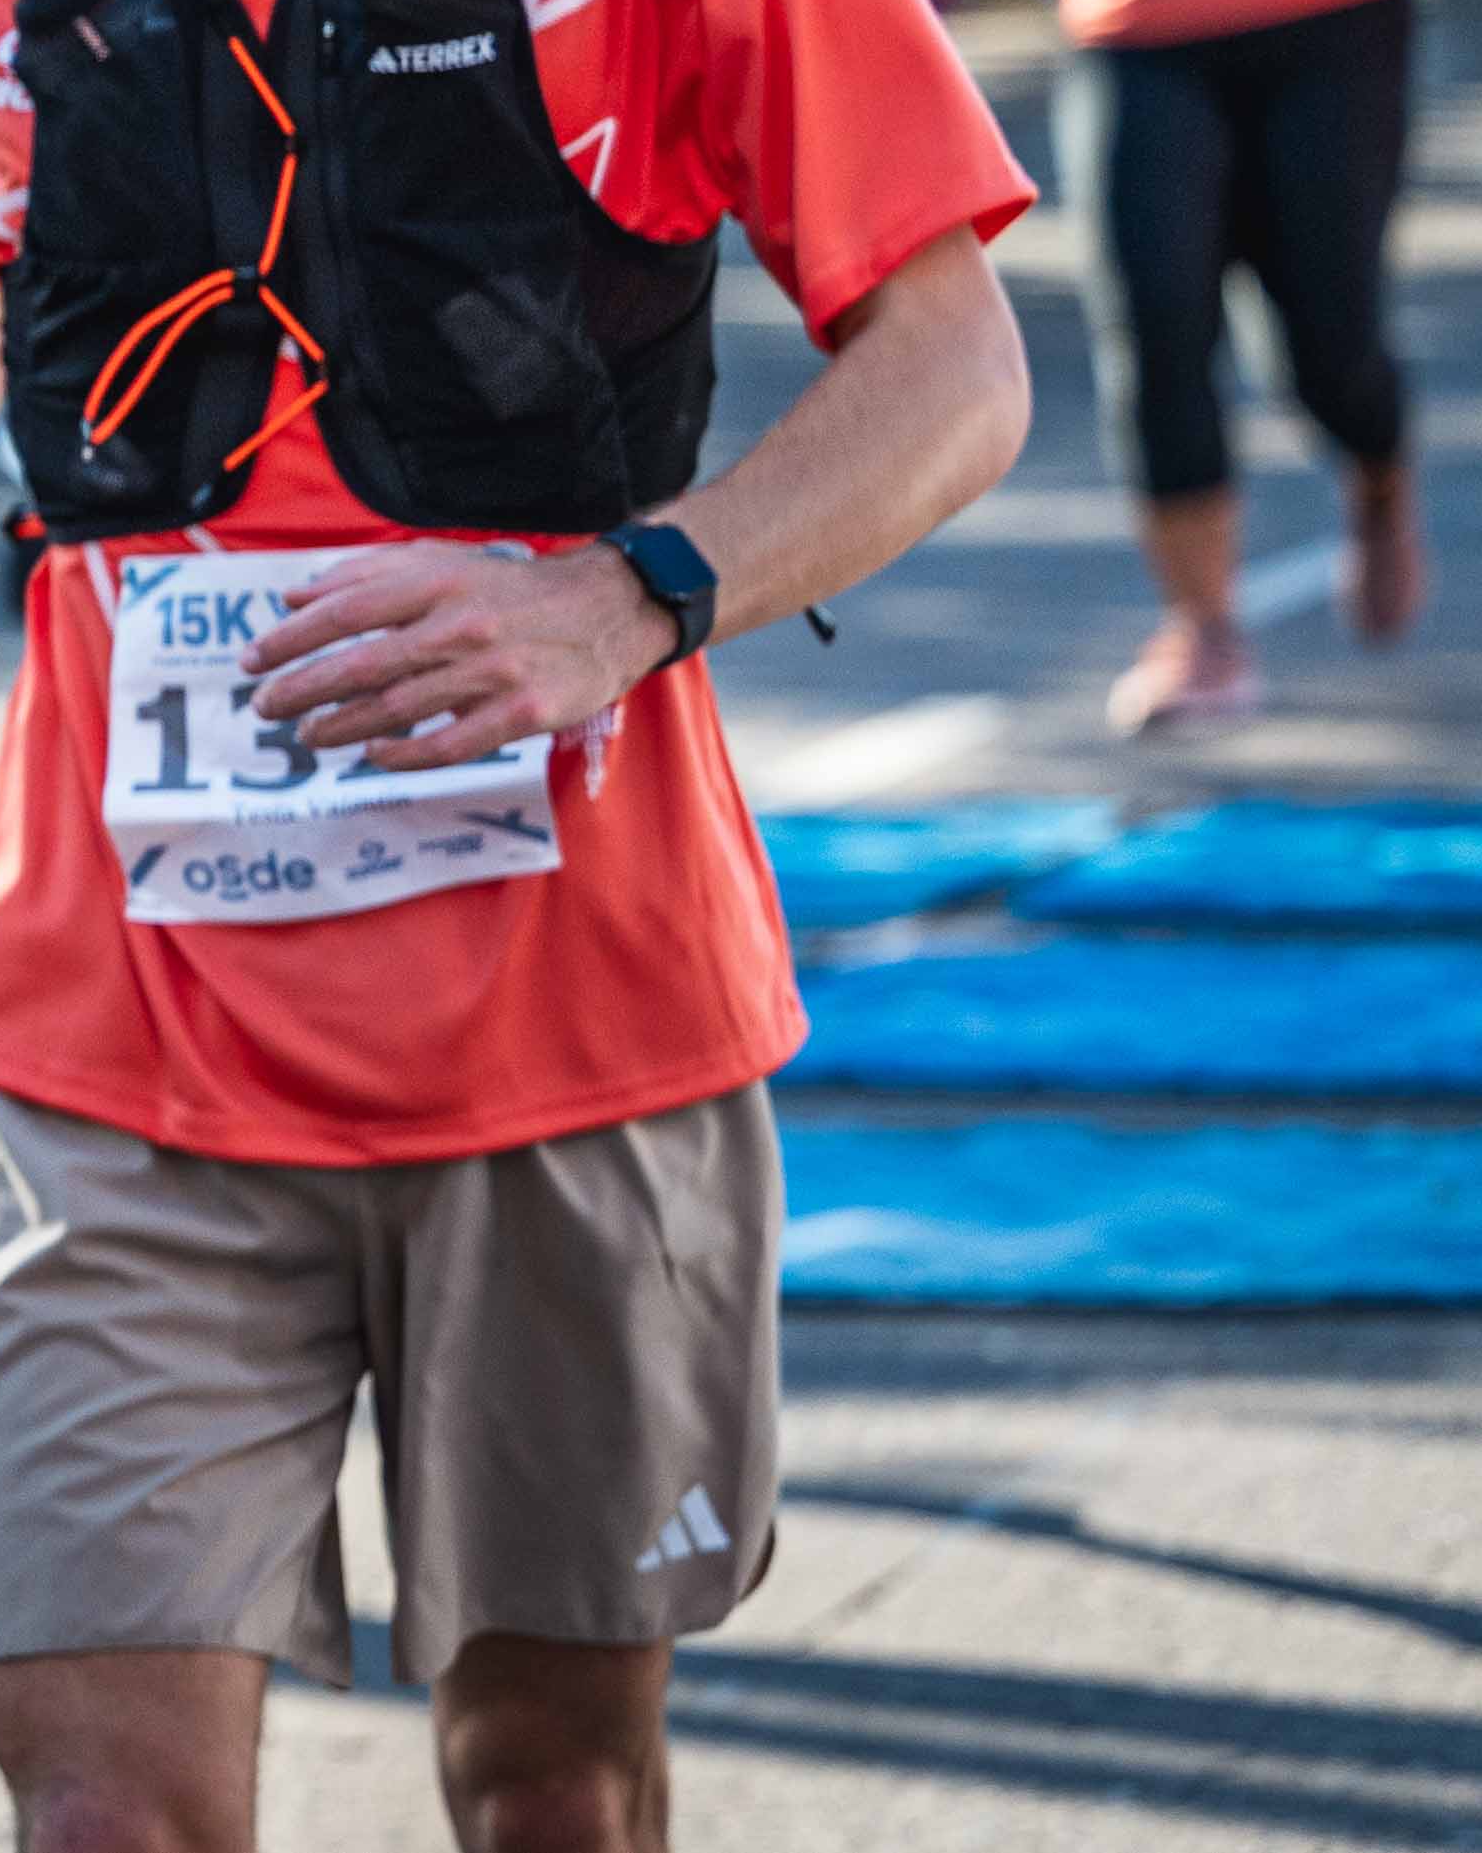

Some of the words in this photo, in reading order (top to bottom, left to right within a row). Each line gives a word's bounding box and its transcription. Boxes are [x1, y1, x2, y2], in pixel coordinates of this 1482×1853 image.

[395, 31, 496, 73] TERREX
[156, 590, 258, 648] 15K
[132, 678, 522, 791] 13
[182, 850, 316, 894] osde
